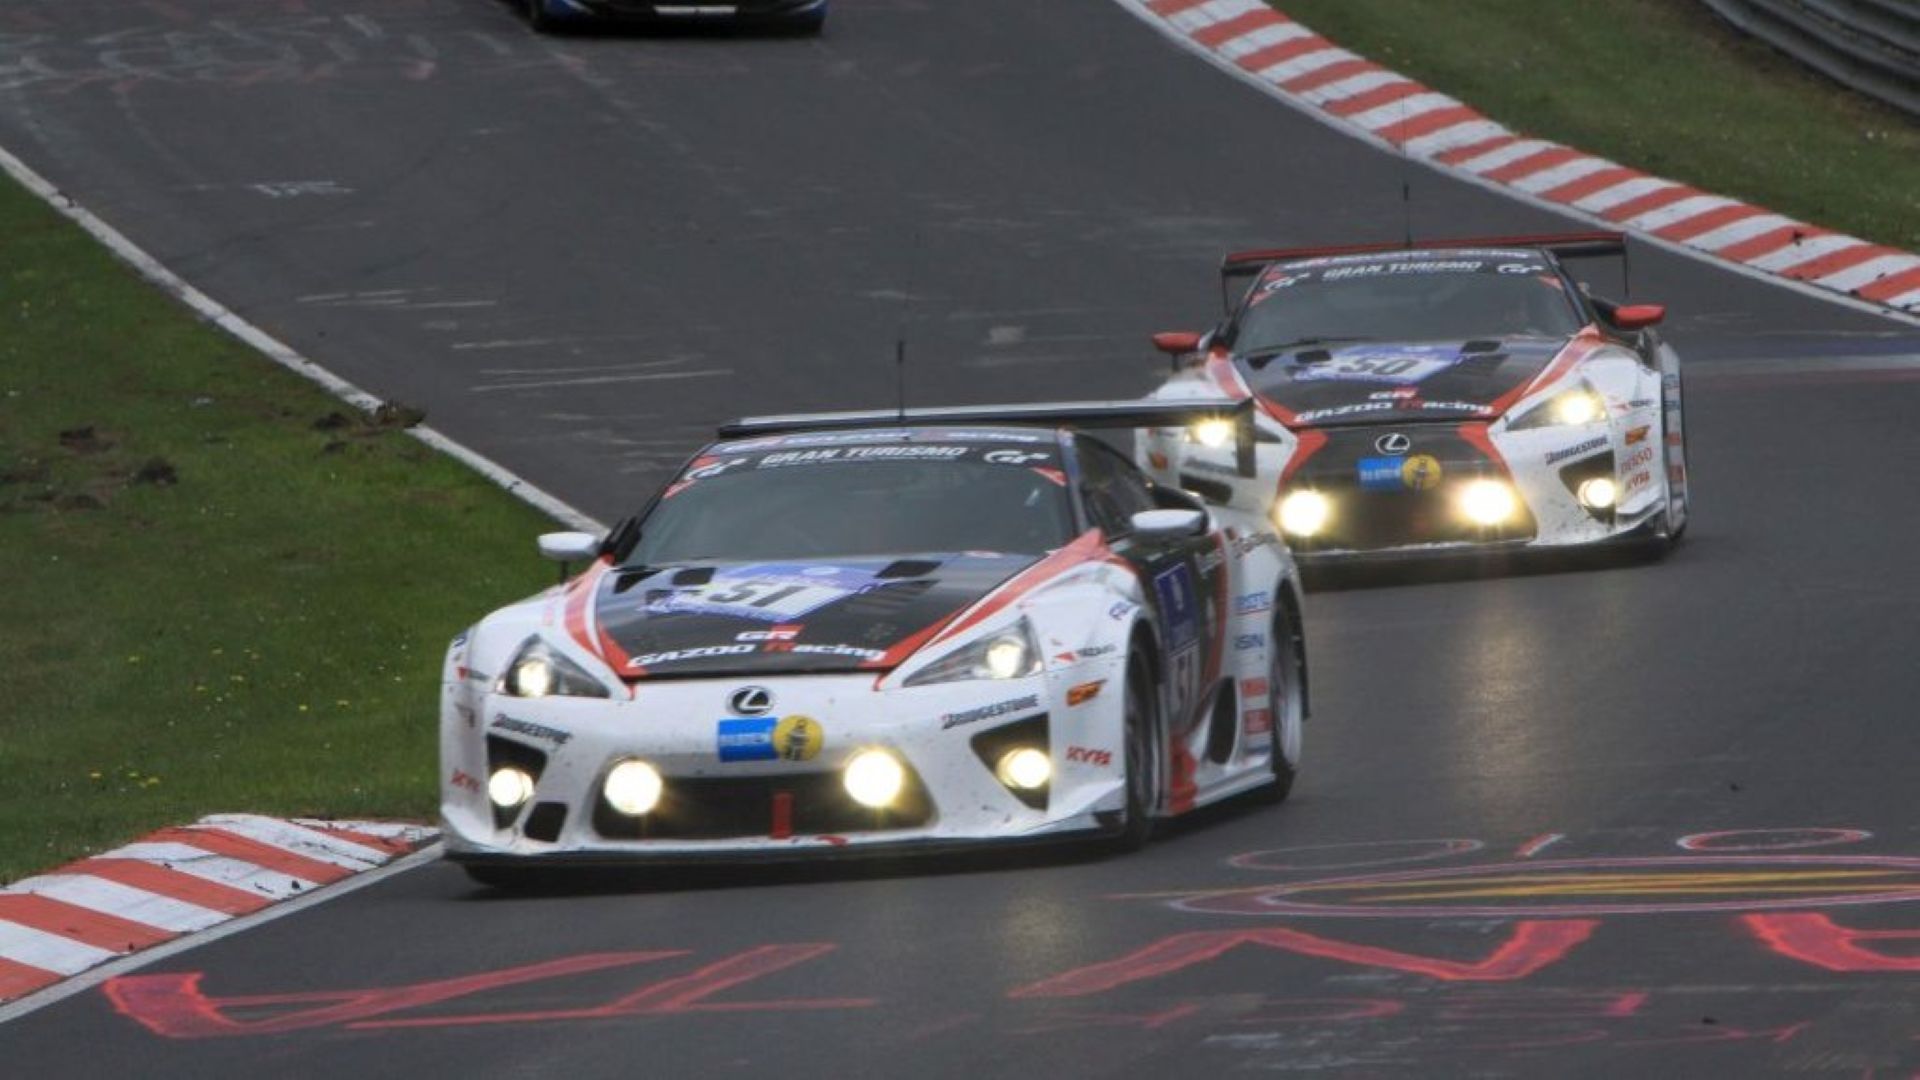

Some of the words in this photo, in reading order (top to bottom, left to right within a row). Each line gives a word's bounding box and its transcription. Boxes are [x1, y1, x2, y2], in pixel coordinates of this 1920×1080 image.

[1322, 263, 1384, 281] GRAN
[1387, 260, 1483, 275] TURISMO
[1339, 358, 1420, 375] 50
[1294, 401, 1393, 423] GAZOO
[758, 449, 841, 467] GRAN
[845, 446, 968, 460] TURISMO
[708, 580, 807, 608] 51
[626, 643, 757, 669] GAZOO
[760, 641, 889, 663] Racing
